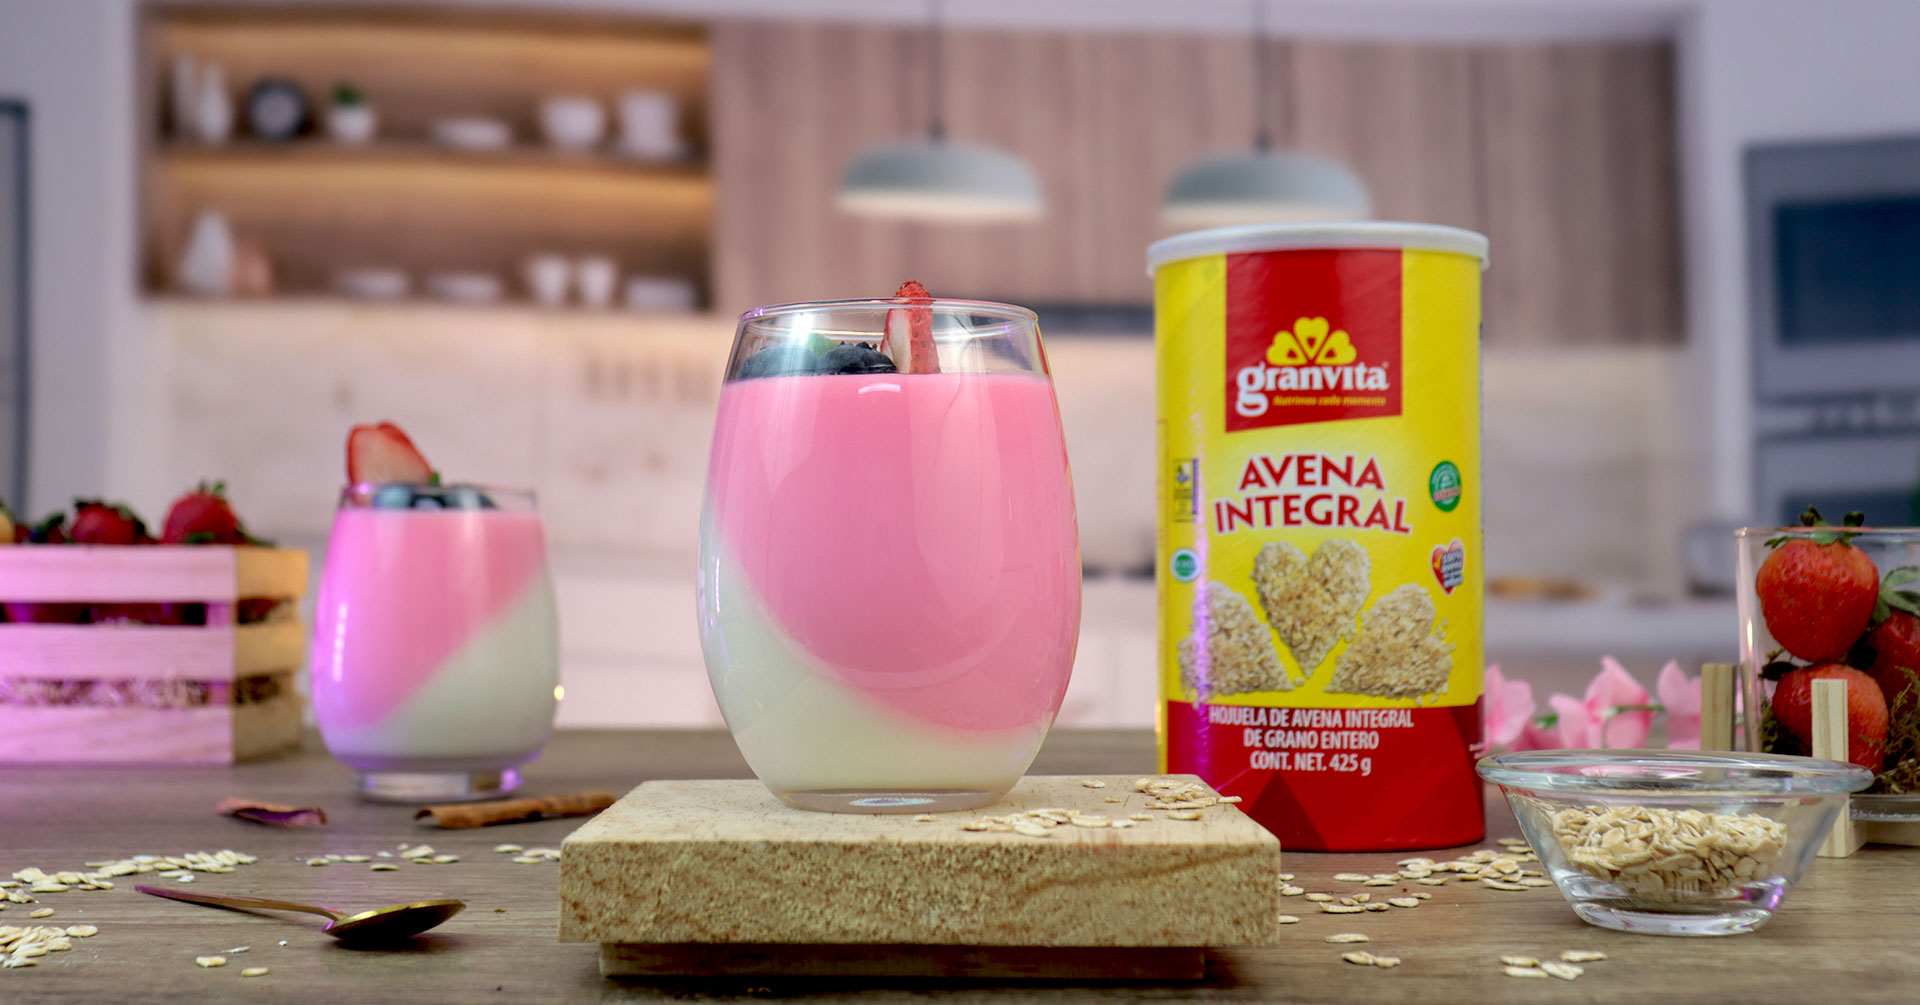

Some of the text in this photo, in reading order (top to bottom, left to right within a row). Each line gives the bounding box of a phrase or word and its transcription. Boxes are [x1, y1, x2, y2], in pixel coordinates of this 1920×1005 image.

[1236, 361, 1390, 417] granvita
[1238, 453, 1385, 491] AVENA
[1214, 493, 1411, 534] INTEGRAL
[1209, 706, 1415, 728] HOJUELA DE AVENA INTEGRAL
[1243, 728, 1380, 750] DE GRANO ENTERO
[1250, 751, 1372, 777] CONT. NET. 425 g
